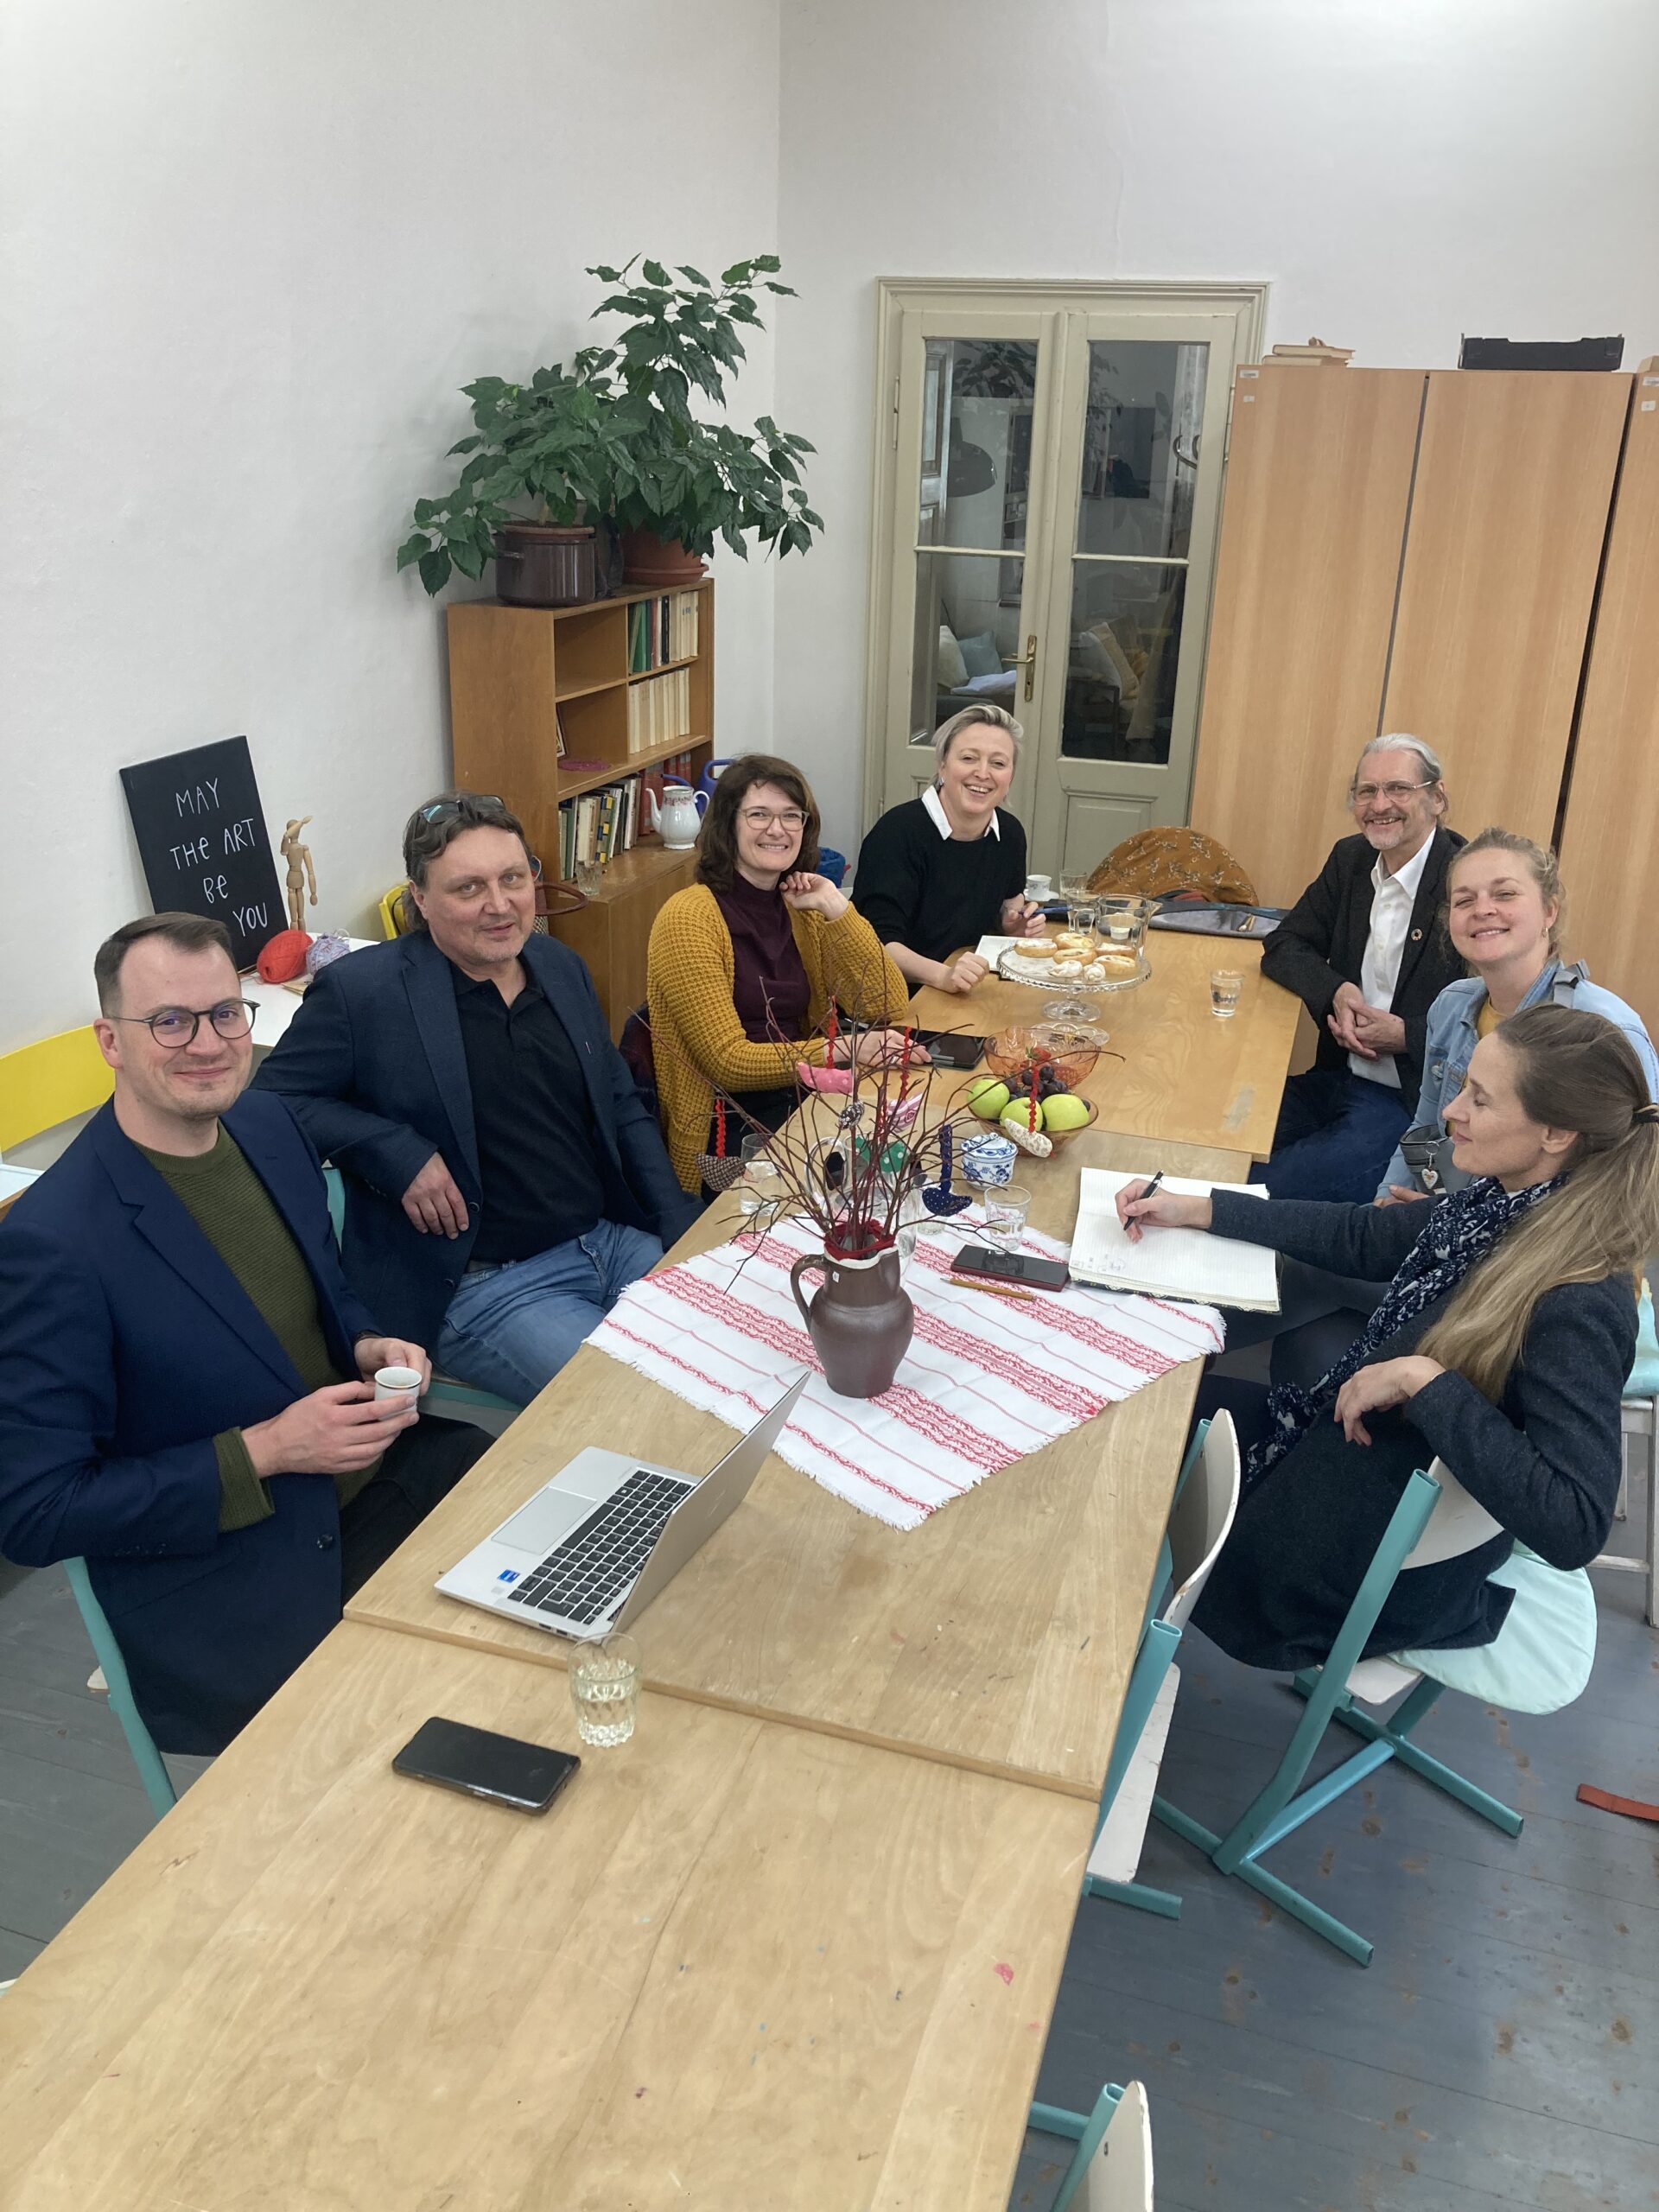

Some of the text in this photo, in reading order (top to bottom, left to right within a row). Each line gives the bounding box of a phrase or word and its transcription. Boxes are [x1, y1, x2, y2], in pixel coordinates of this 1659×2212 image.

[175, 778, 219, 817] MAY
[224, 818, 256, 855] ART
[232, 902, 268, 937] YOU
